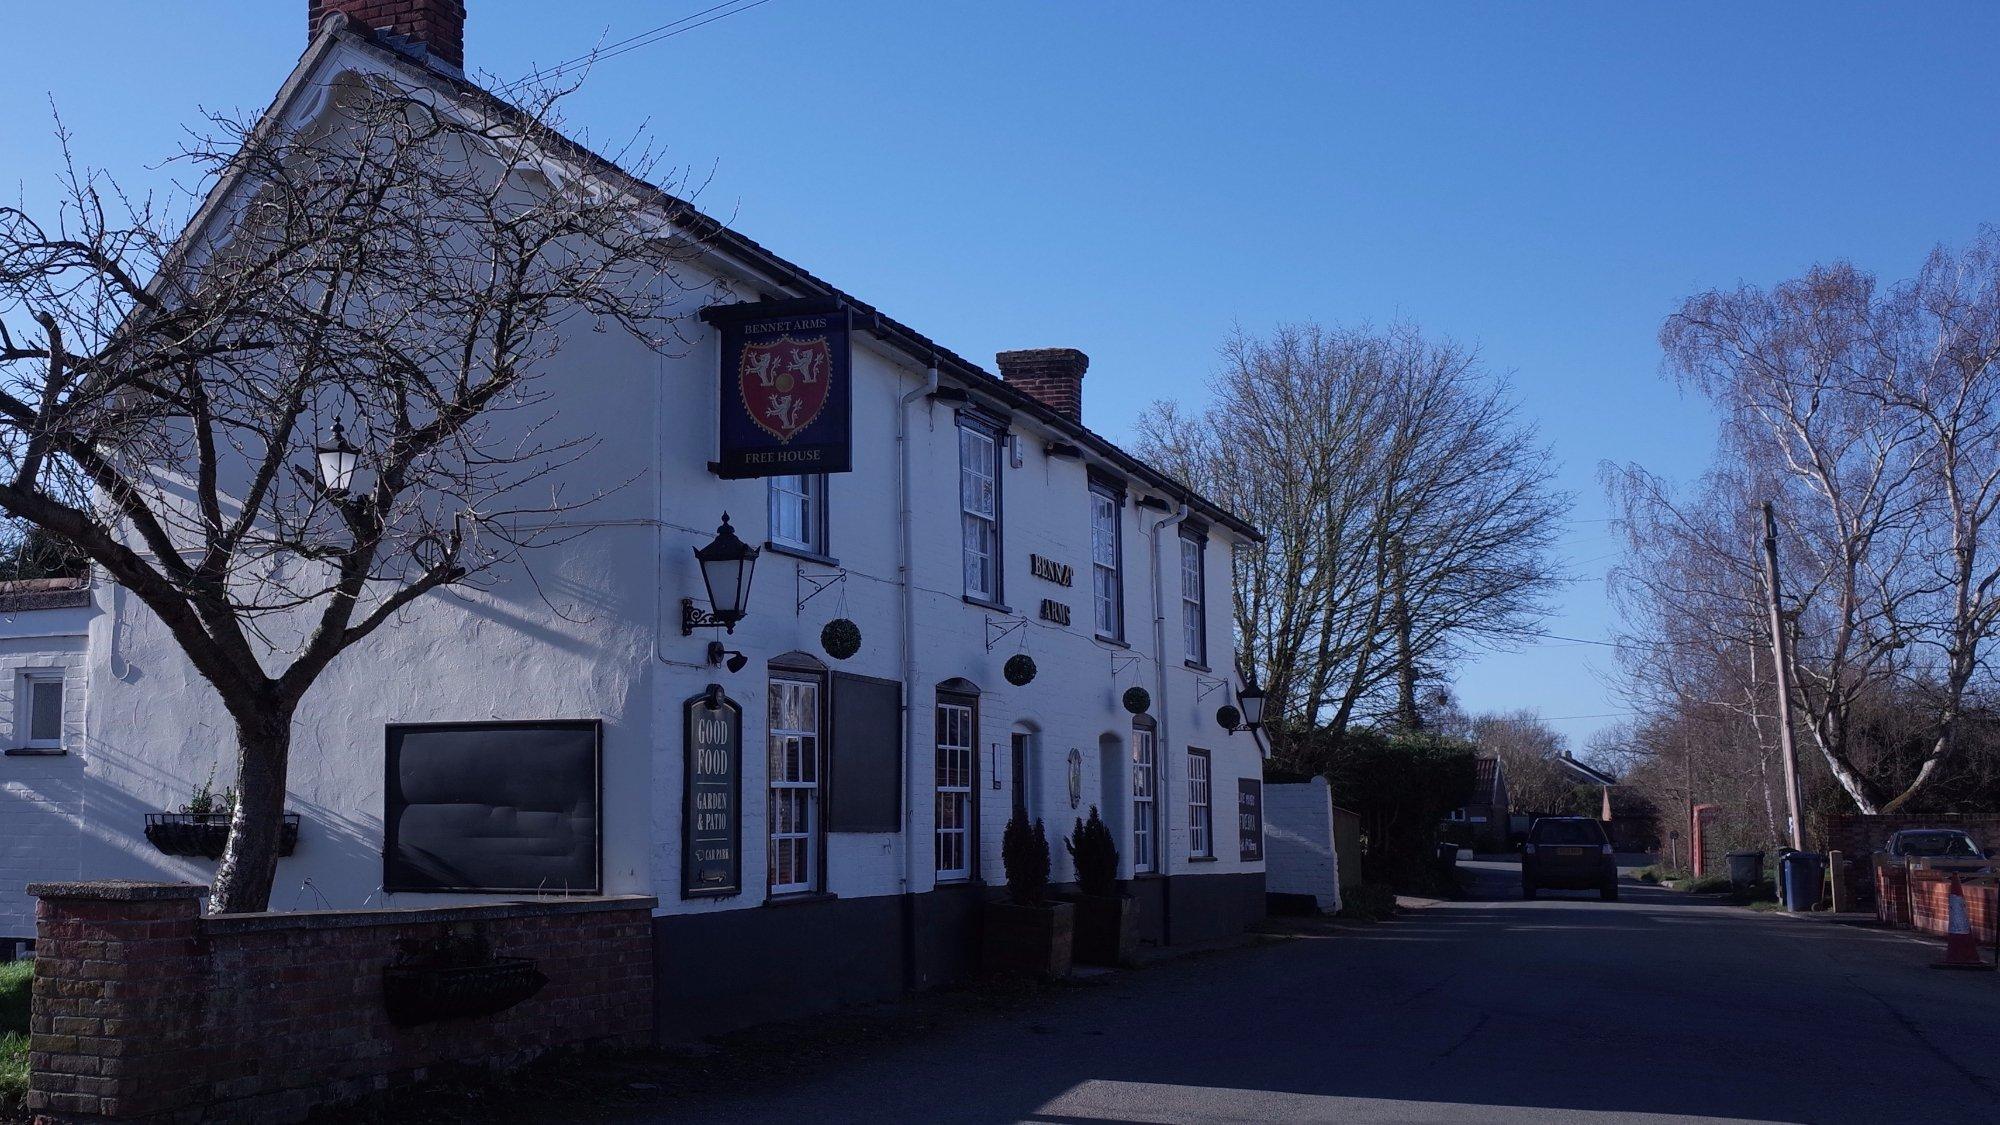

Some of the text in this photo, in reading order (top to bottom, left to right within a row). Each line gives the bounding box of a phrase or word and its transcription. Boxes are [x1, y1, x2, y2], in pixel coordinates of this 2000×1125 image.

[745, 318, 827, 334] BENNET ARMS
[745, 449, 821, 464] FREE HOUSE
[1041, 598, 1071, 626] ARMS
[698, 719, 728, 745] GOOD
[697, 748, 728, 775] FOOD
[697, 792, 727, 810] GARDEN
[697, 813, 727, 831] & PATIO
[705, 848, 729, 860] CAR PARK
